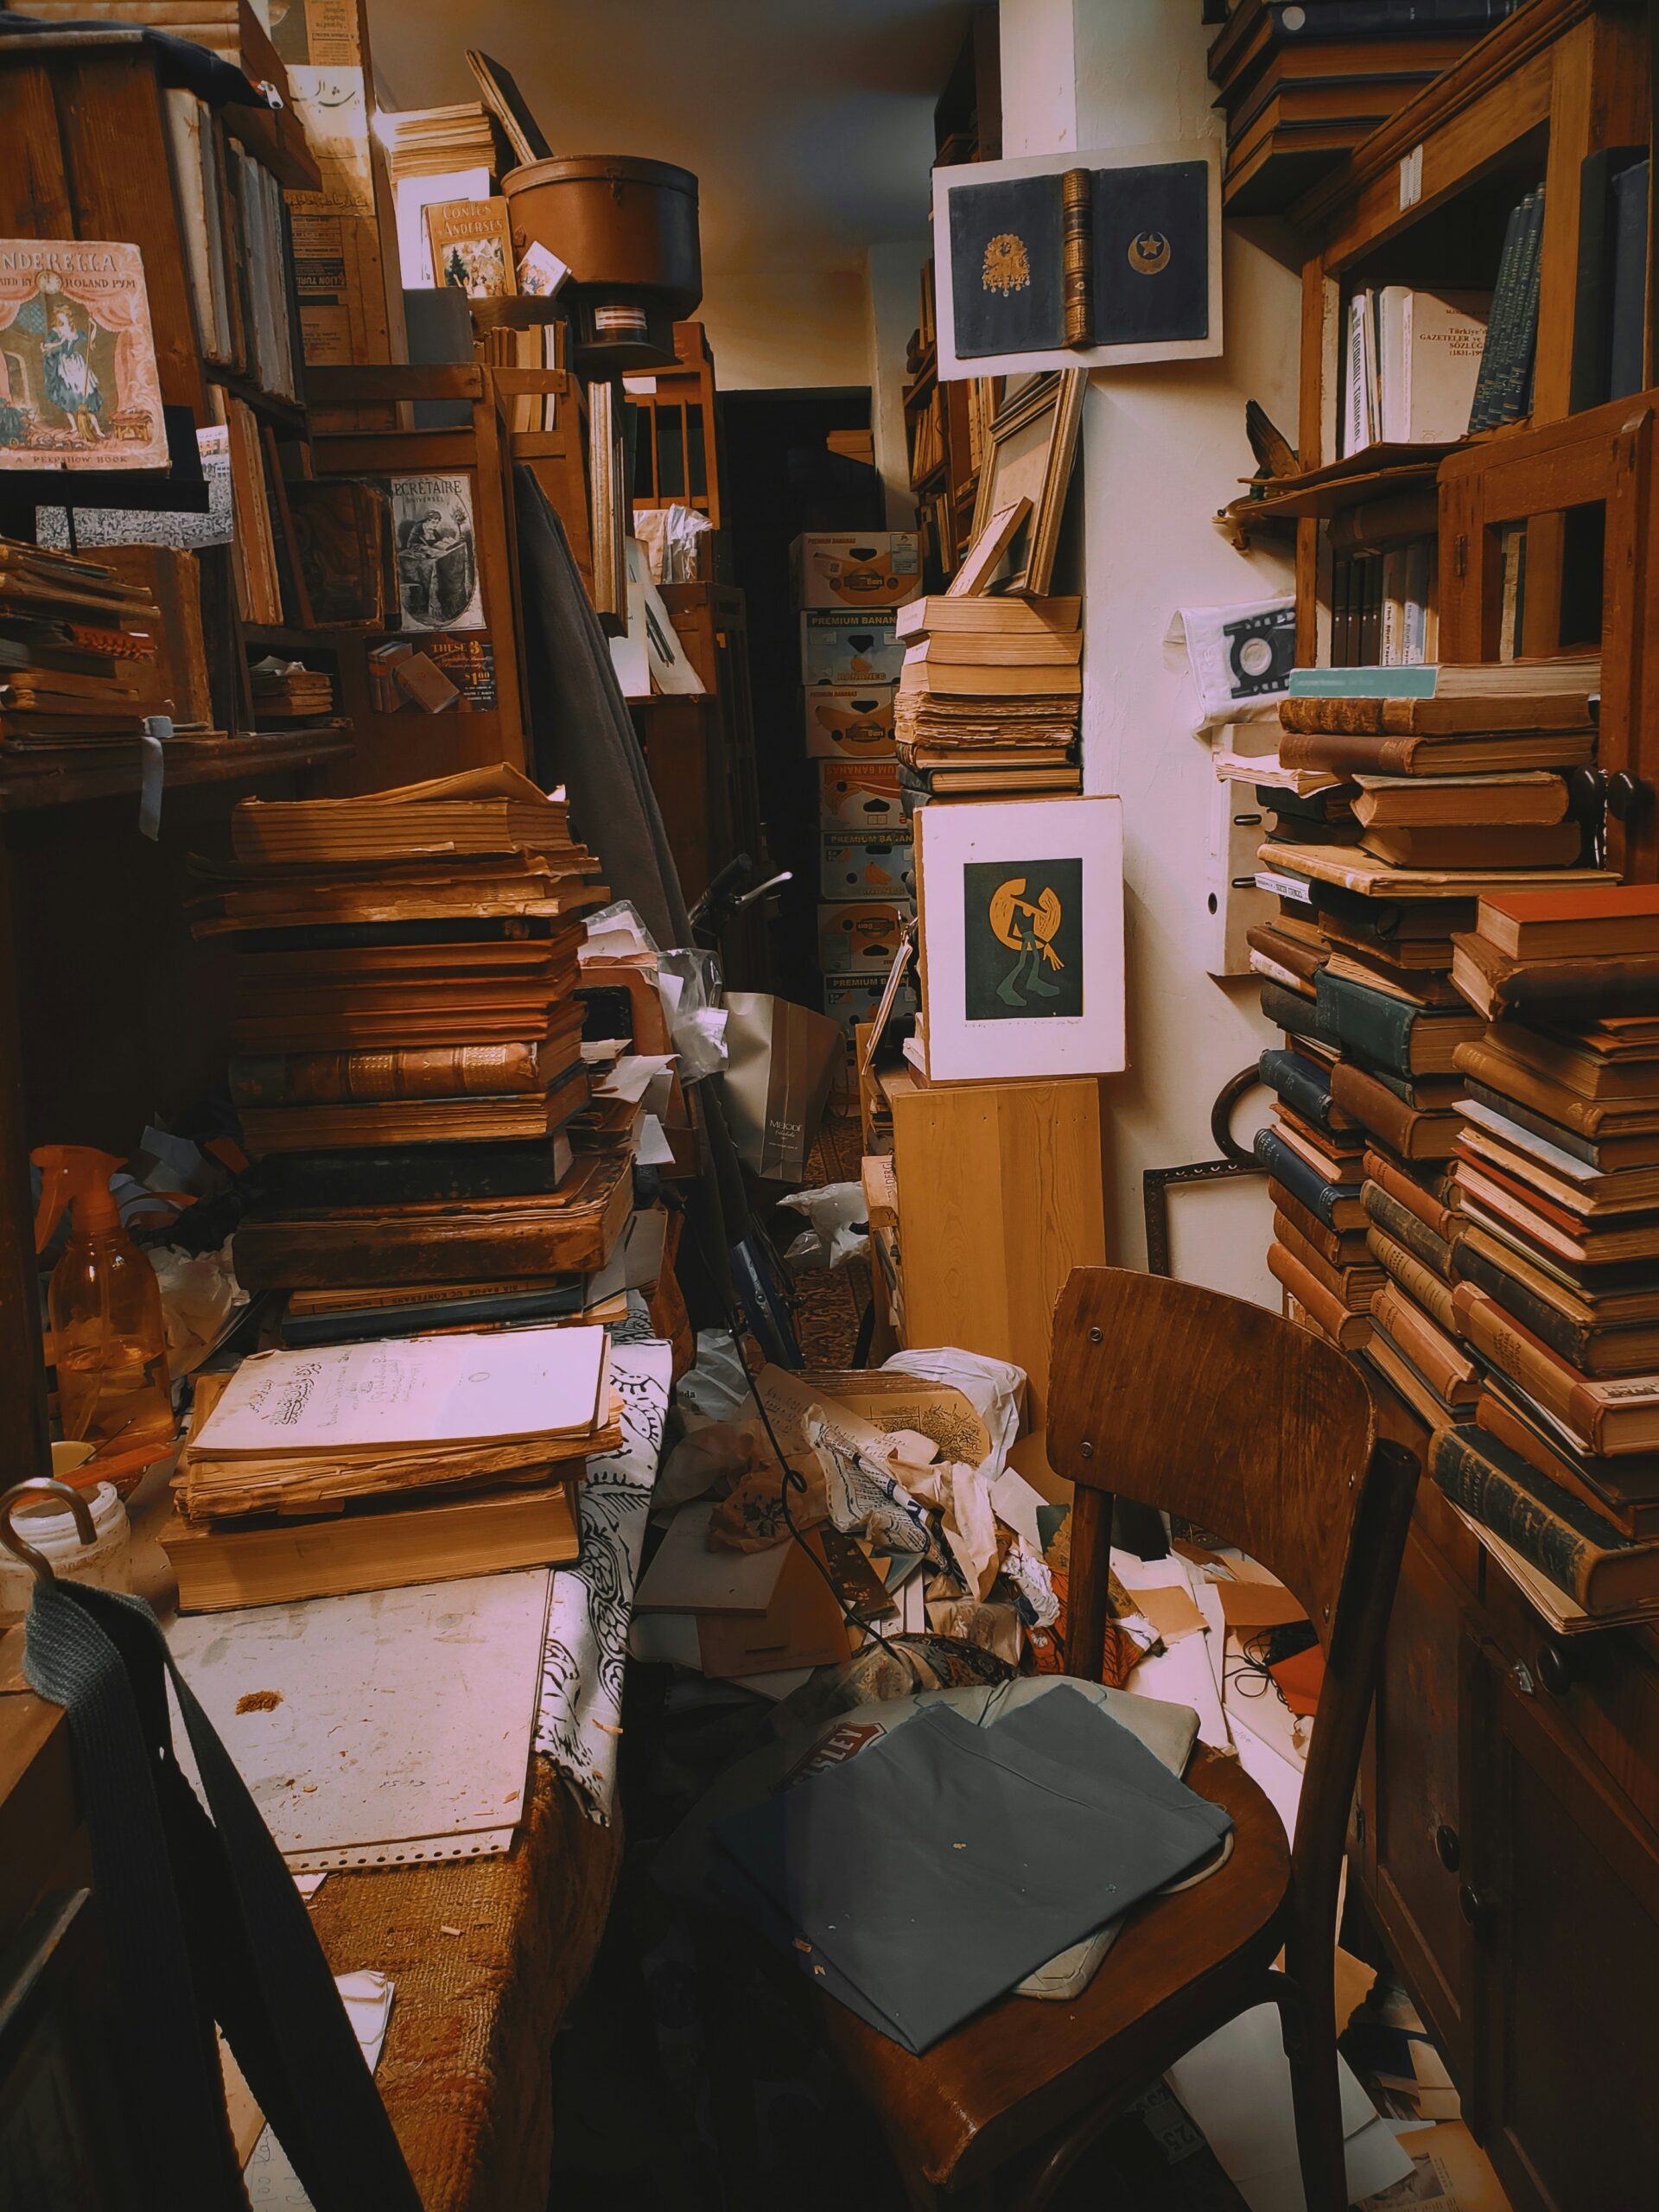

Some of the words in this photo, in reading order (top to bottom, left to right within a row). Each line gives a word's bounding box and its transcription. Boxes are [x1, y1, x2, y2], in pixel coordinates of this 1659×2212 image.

[0, 252, 118, 272] NDERELLA
[66, 278, 109, 289] ROLAND
[111, 279, 136, 289] PYM
[811, 616, 859, 626] PREMIUM
[861, 616, 897, 625] BANAN
[433, 643, 467, 653] THESE
[469, 640, 480, 655] 3
[830, 835, 877, 843] PREMIUM
[833, 977, 878, 987] PREMIUM
